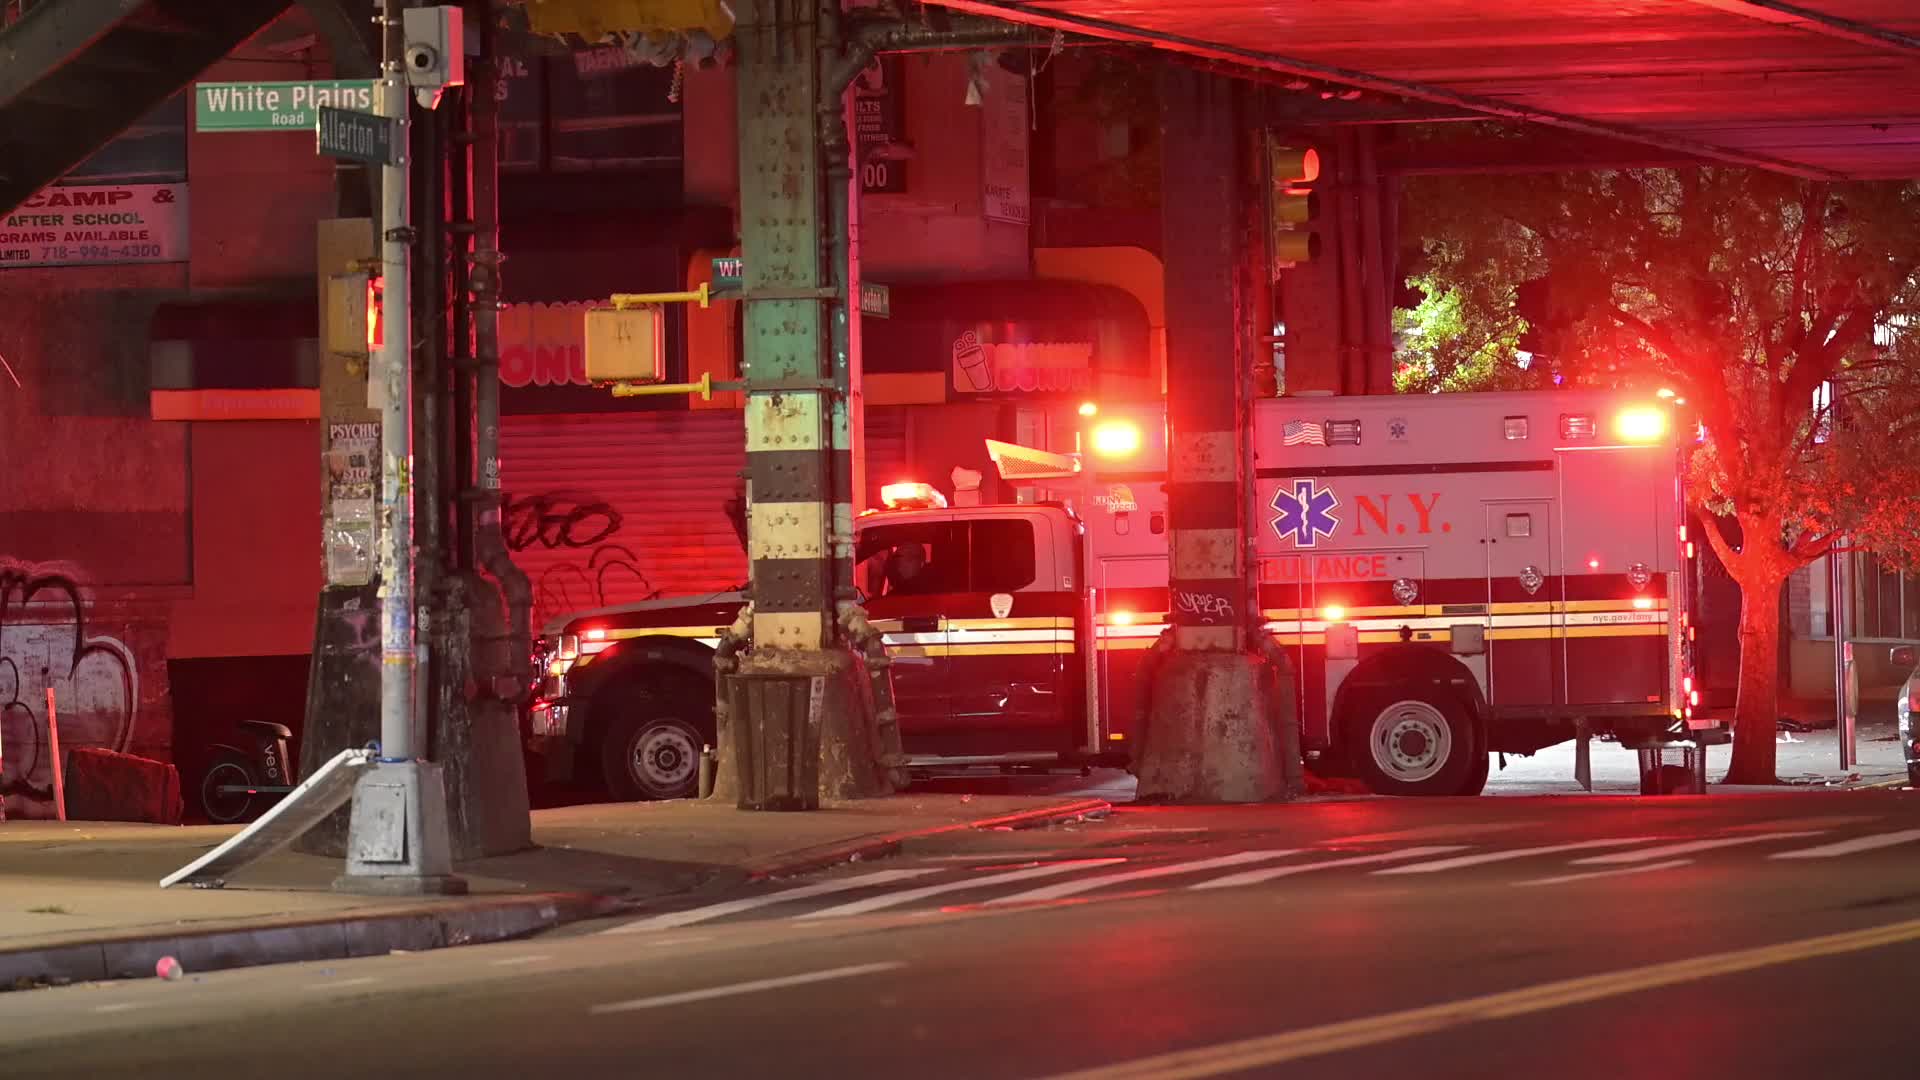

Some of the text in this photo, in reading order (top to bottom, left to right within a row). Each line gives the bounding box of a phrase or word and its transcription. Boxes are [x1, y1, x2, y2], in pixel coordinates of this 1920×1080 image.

[207, 84, 370, 112] White Plains
[272, 112, 304, 126] Road
[320, 111, 374, 155] Allerton
[23, 188, 175, 208] CAMP &
[7, 212, 145, 228] AFTER SCHOOL
[64, 230, 149, 243] AVAILABLE
[330, 423, 380, 441] PSYCHIC
[1352, 493, 1452, 536] N.Y.
[264, 744, 277, 778] veo
